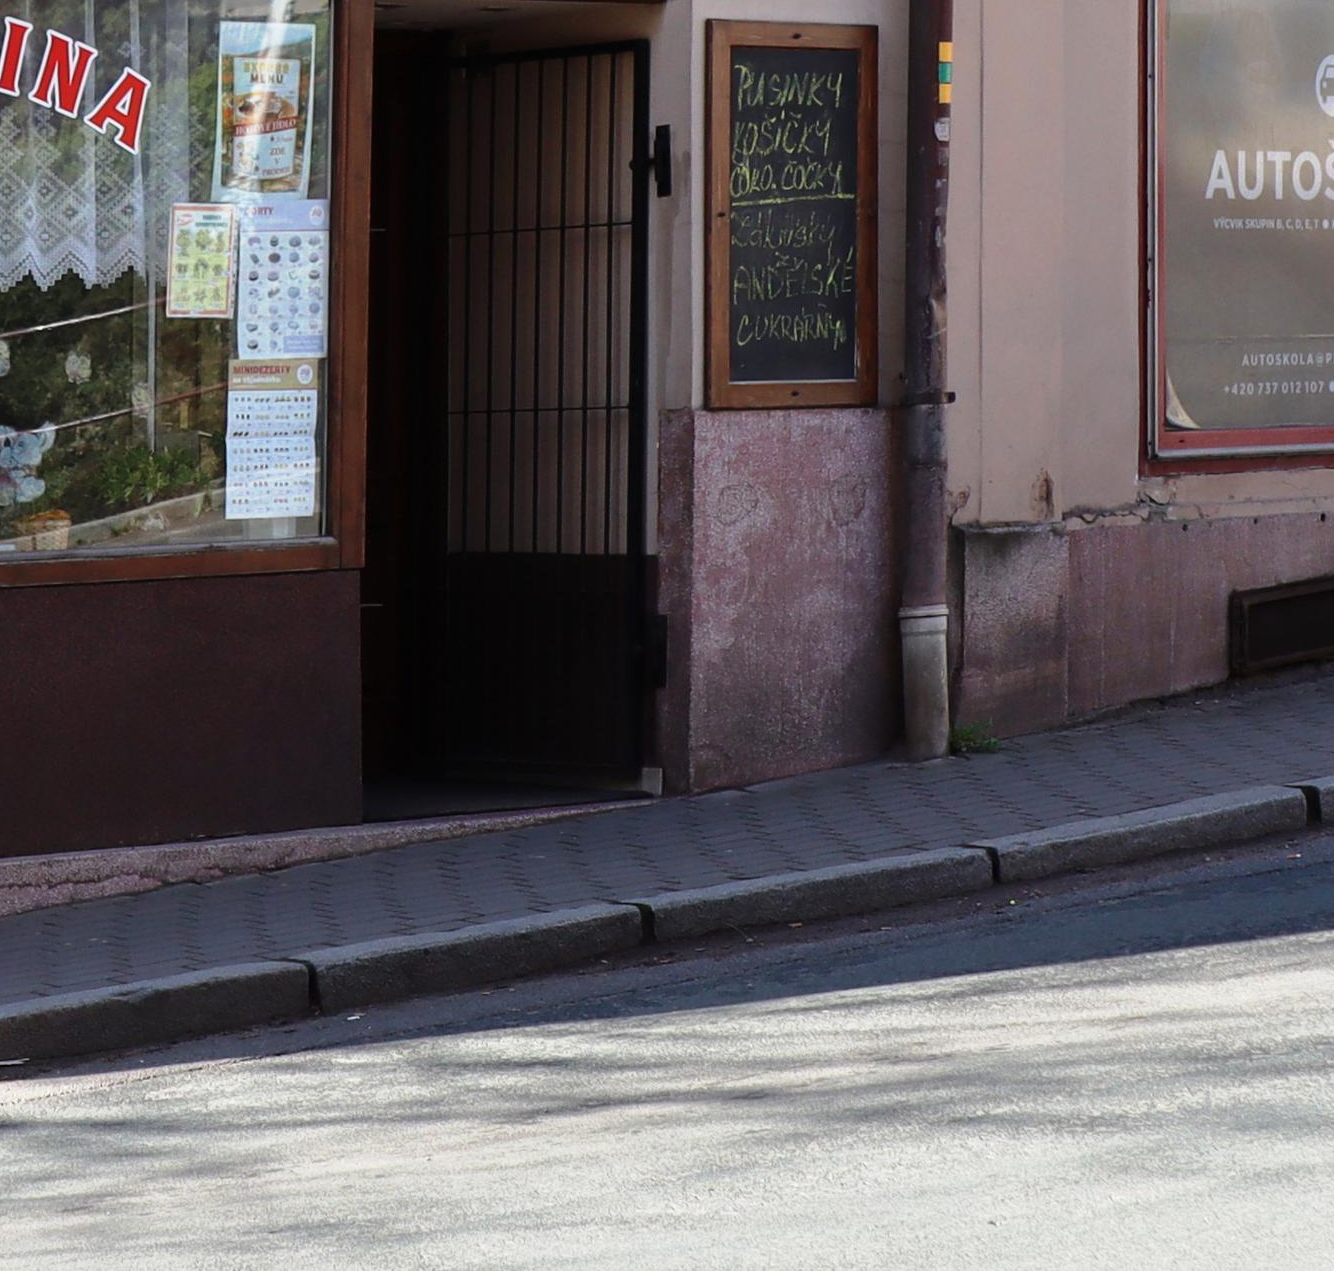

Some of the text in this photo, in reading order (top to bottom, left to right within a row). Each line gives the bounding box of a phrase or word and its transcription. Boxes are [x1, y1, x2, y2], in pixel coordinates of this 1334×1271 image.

[1223, 382, 1255, 395] +420
[1258, 382, 1278, 394] 737
[1281, 381, 1301, 394] 012
[1304, 380, 1324, 393] 107
